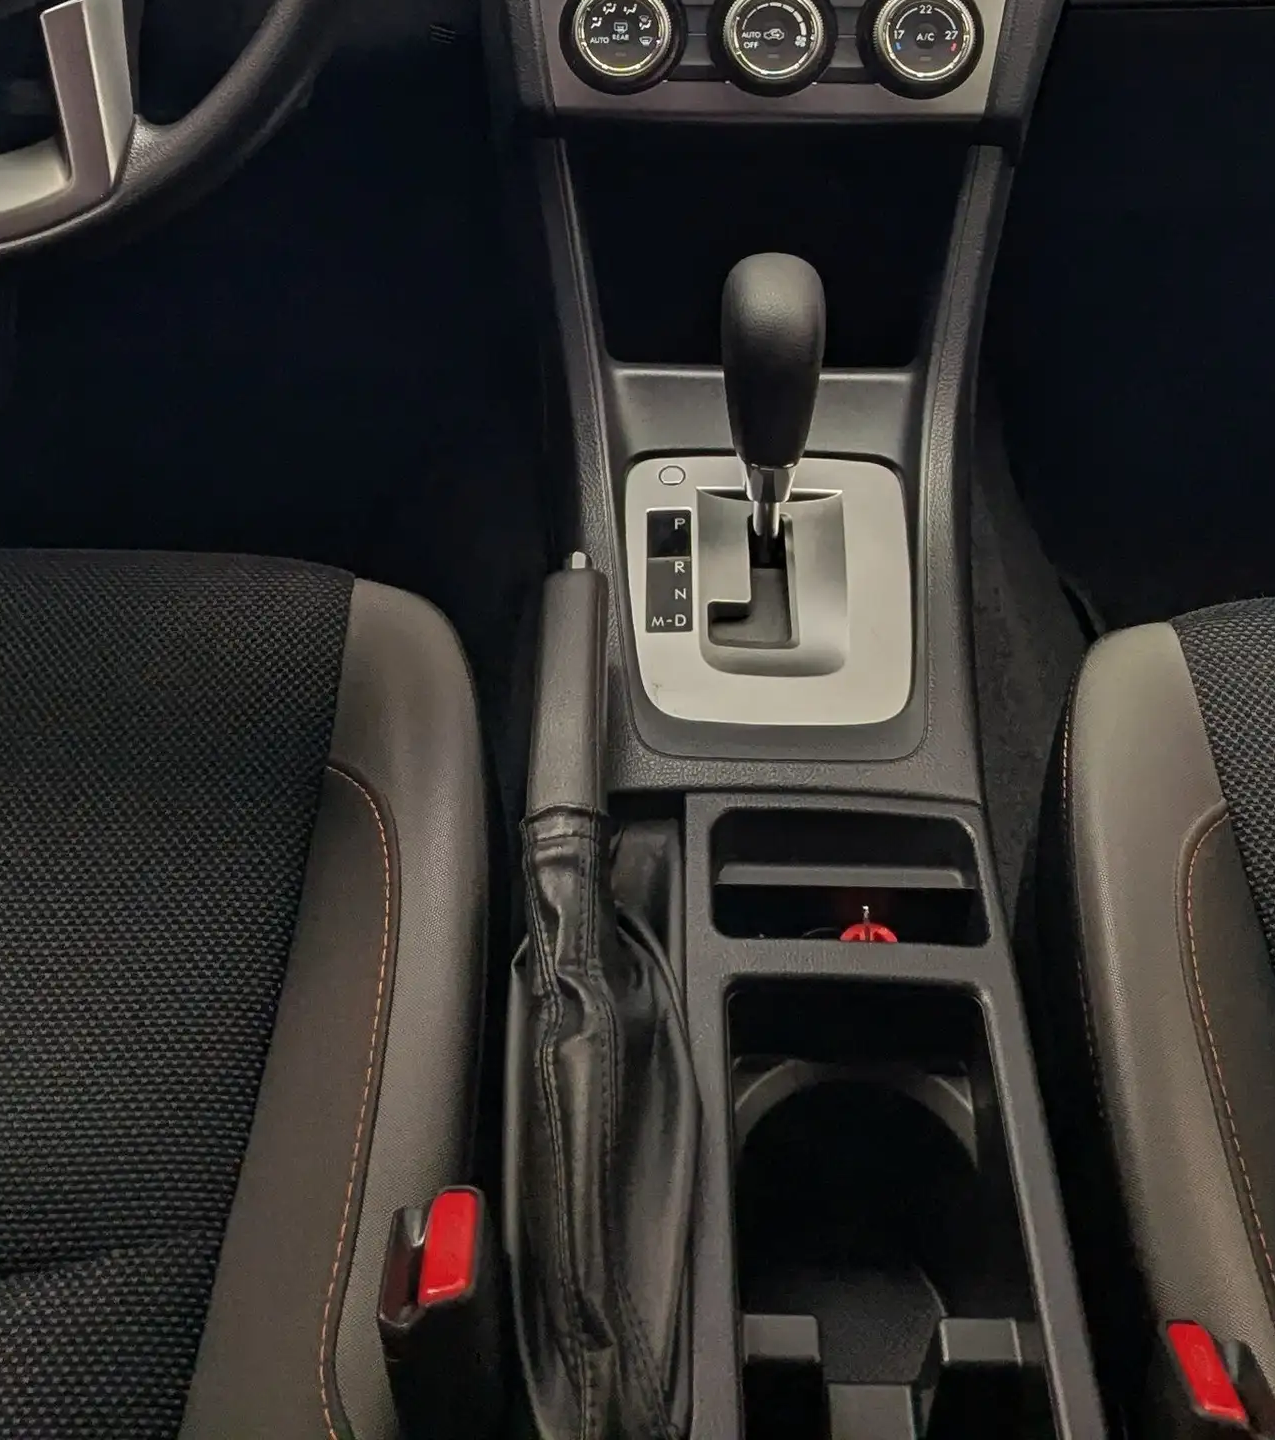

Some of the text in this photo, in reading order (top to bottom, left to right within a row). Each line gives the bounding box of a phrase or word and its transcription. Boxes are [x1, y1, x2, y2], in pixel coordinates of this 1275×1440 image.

[919, 4, 932, 14] 22
[741, 31, 761, 39] AUTO
[893, 30, 905, 40] 17
[915, 32, 935, 42] A/C
[945, 30, 958, 40] 27
[590, 37, 610, 45] AUTO
[743, 41, 759, 49] OFF
[674, 518, 686, 530] P
[674, 561, 686, 573] R
[674, 588, 687, 600] N
